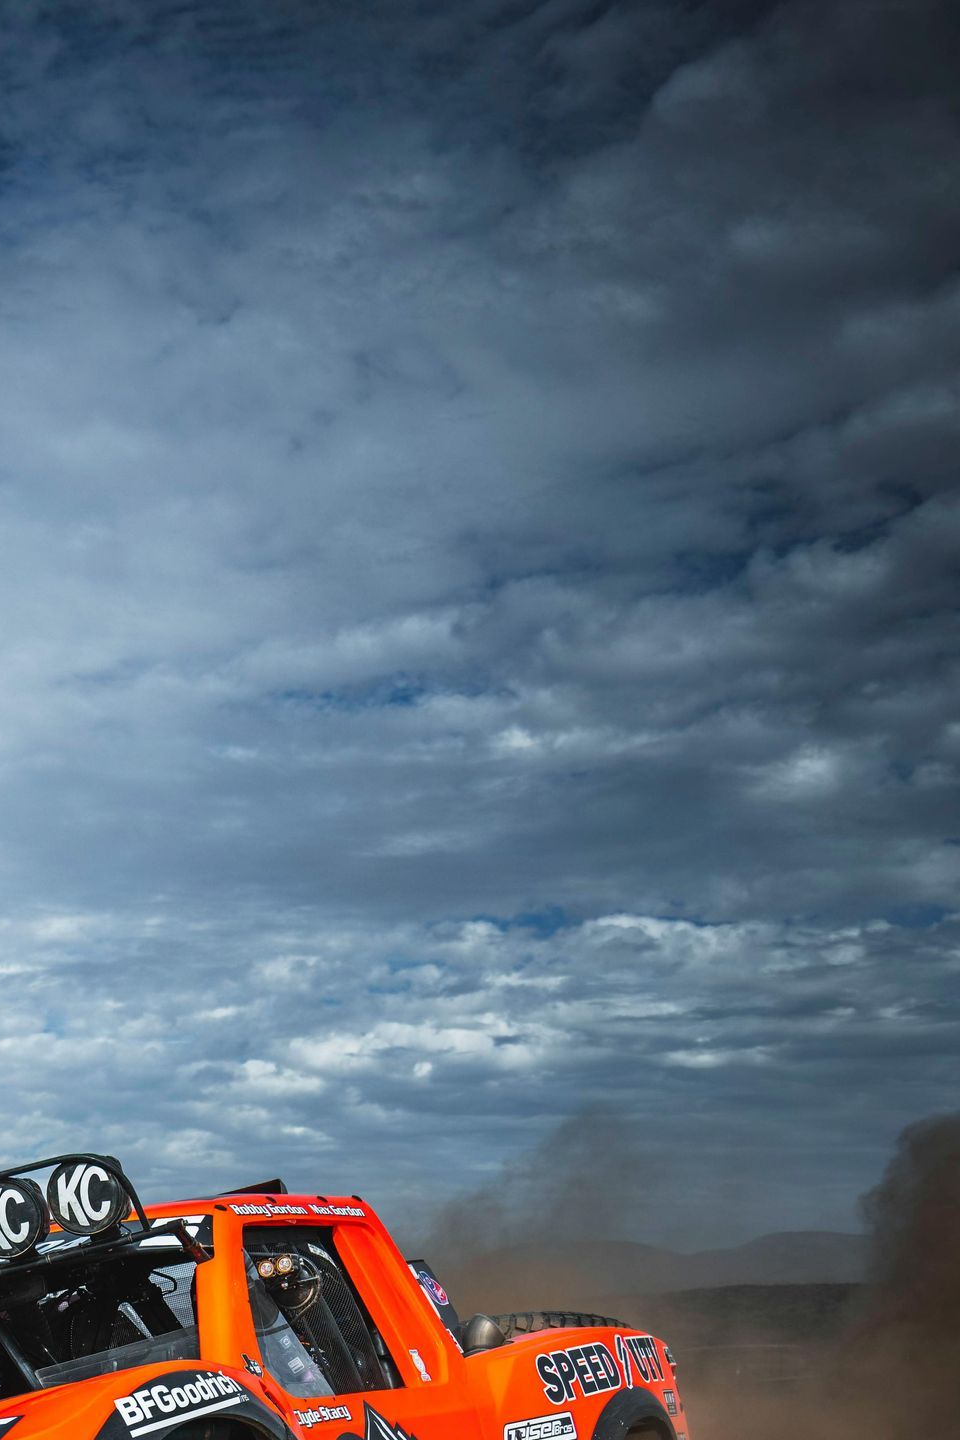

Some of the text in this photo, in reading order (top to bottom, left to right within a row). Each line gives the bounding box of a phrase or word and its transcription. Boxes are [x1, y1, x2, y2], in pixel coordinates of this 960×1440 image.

[57, 1164, 112, 1227] KC
[229, 1204, 308, 1217] Robby Gordon
[308, 1204, 366, 1217] Max Gordon
[536, 1341, 621, 1405] SPEED
[113, 1370, 243, 1426] BFGoodrich
[318, 1405, 352, 1421] Stacy
